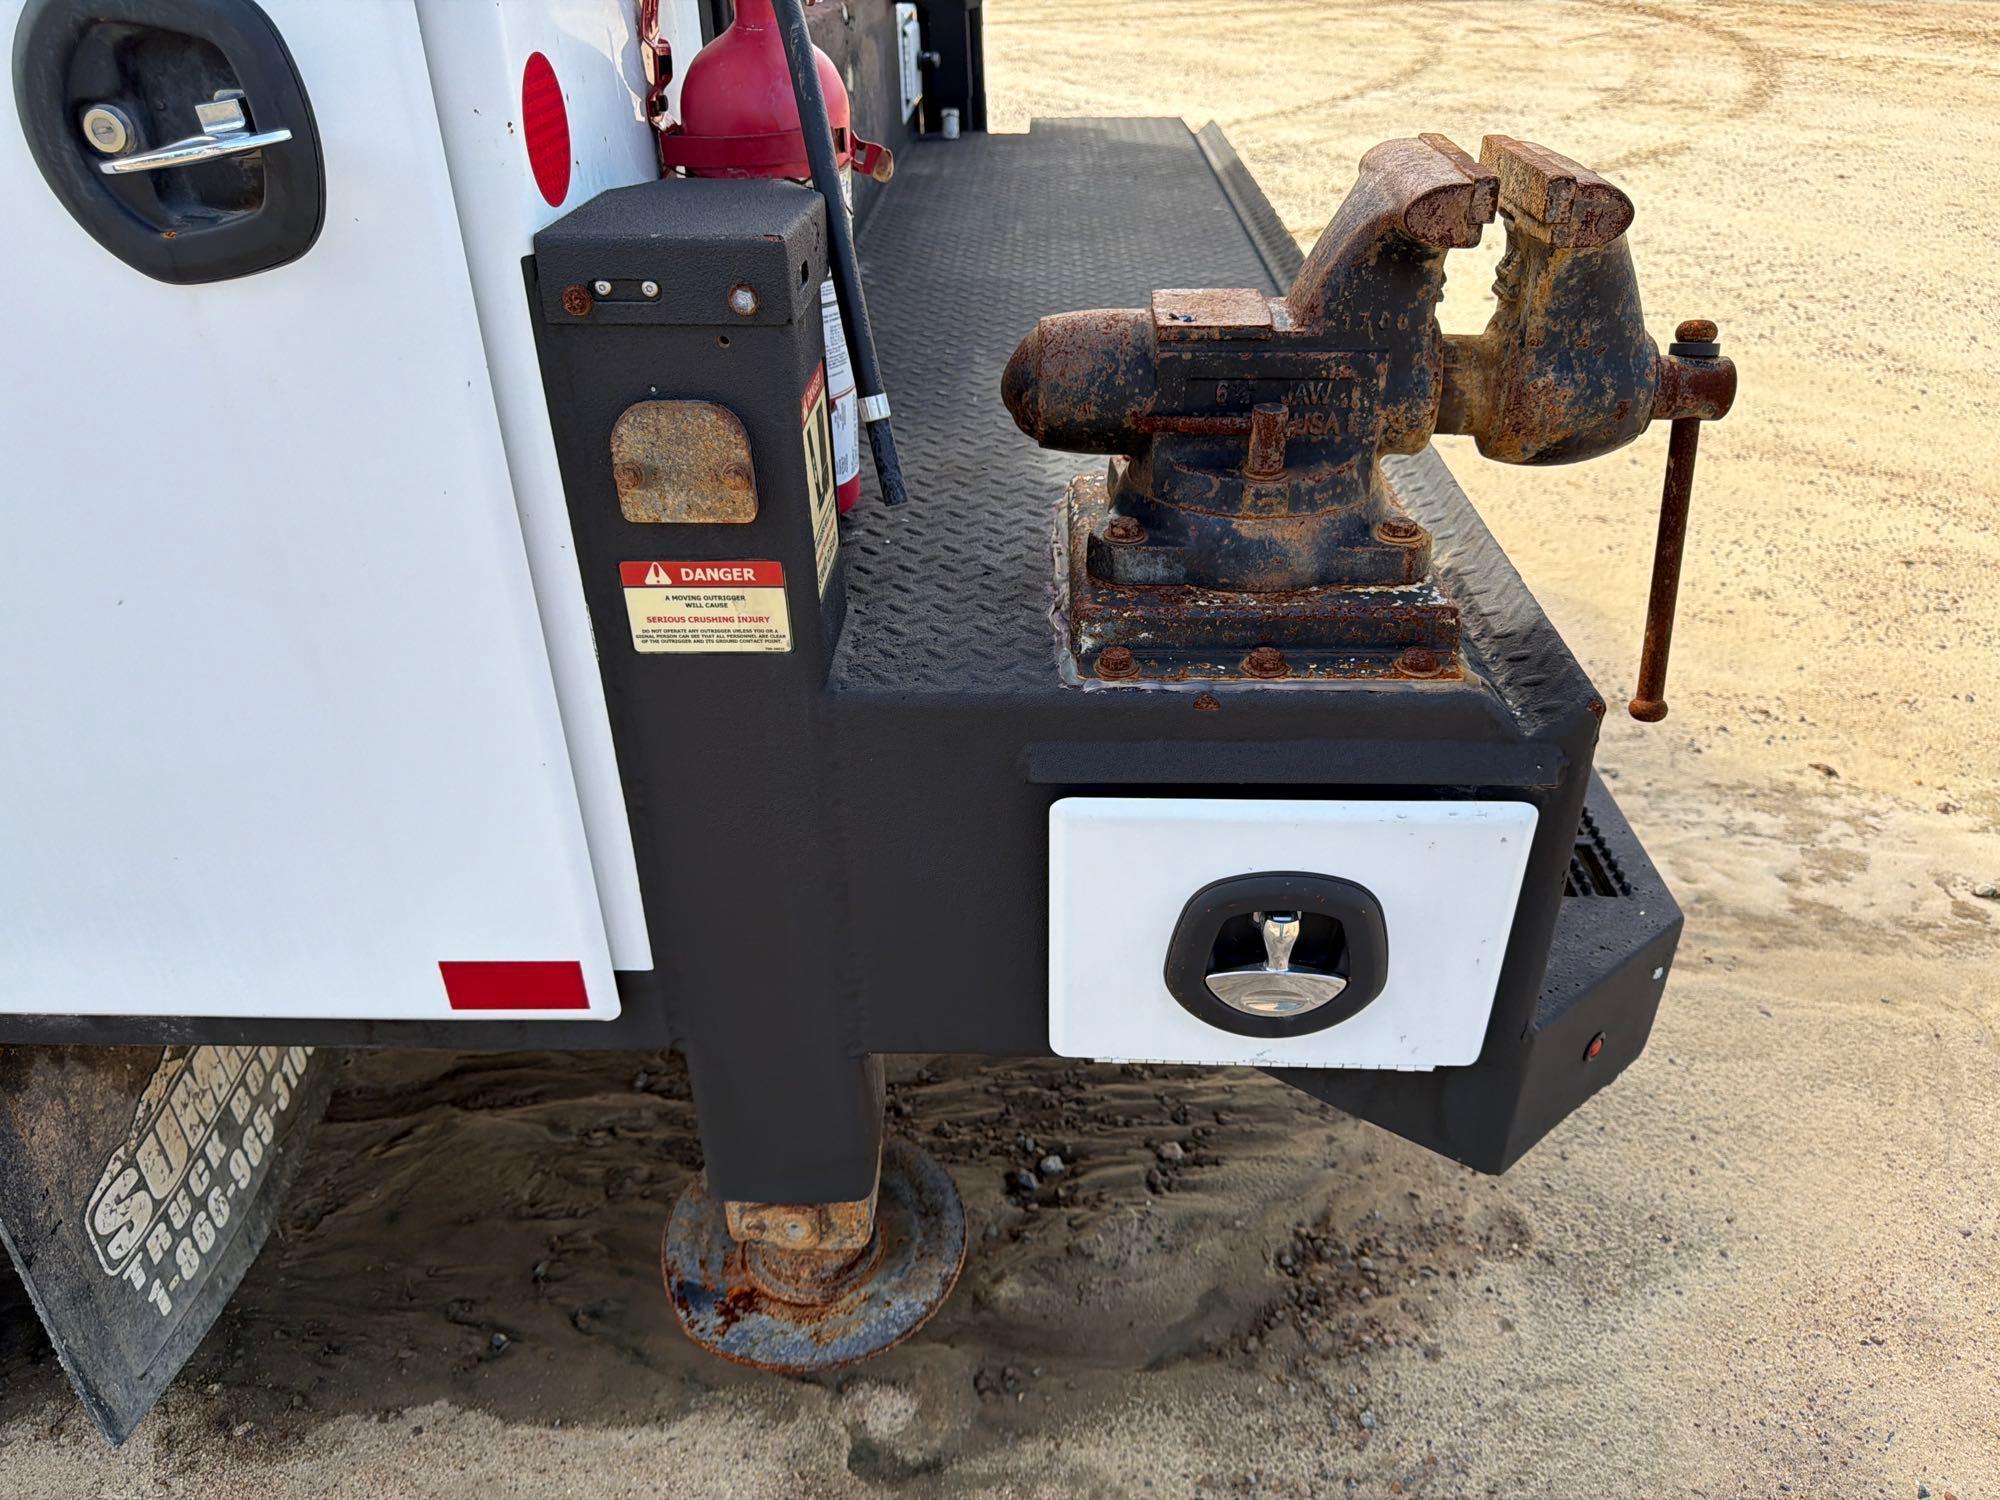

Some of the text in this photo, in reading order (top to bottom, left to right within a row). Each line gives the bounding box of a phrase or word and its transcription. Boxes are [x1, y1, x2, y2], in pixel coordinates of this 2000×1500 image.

[680, 567, 757, 582] DANGER
[646, 616, 771, 624] SERIOUS CRUSHING INJURY
[122, 1129, 227, 1291] TRUCK
